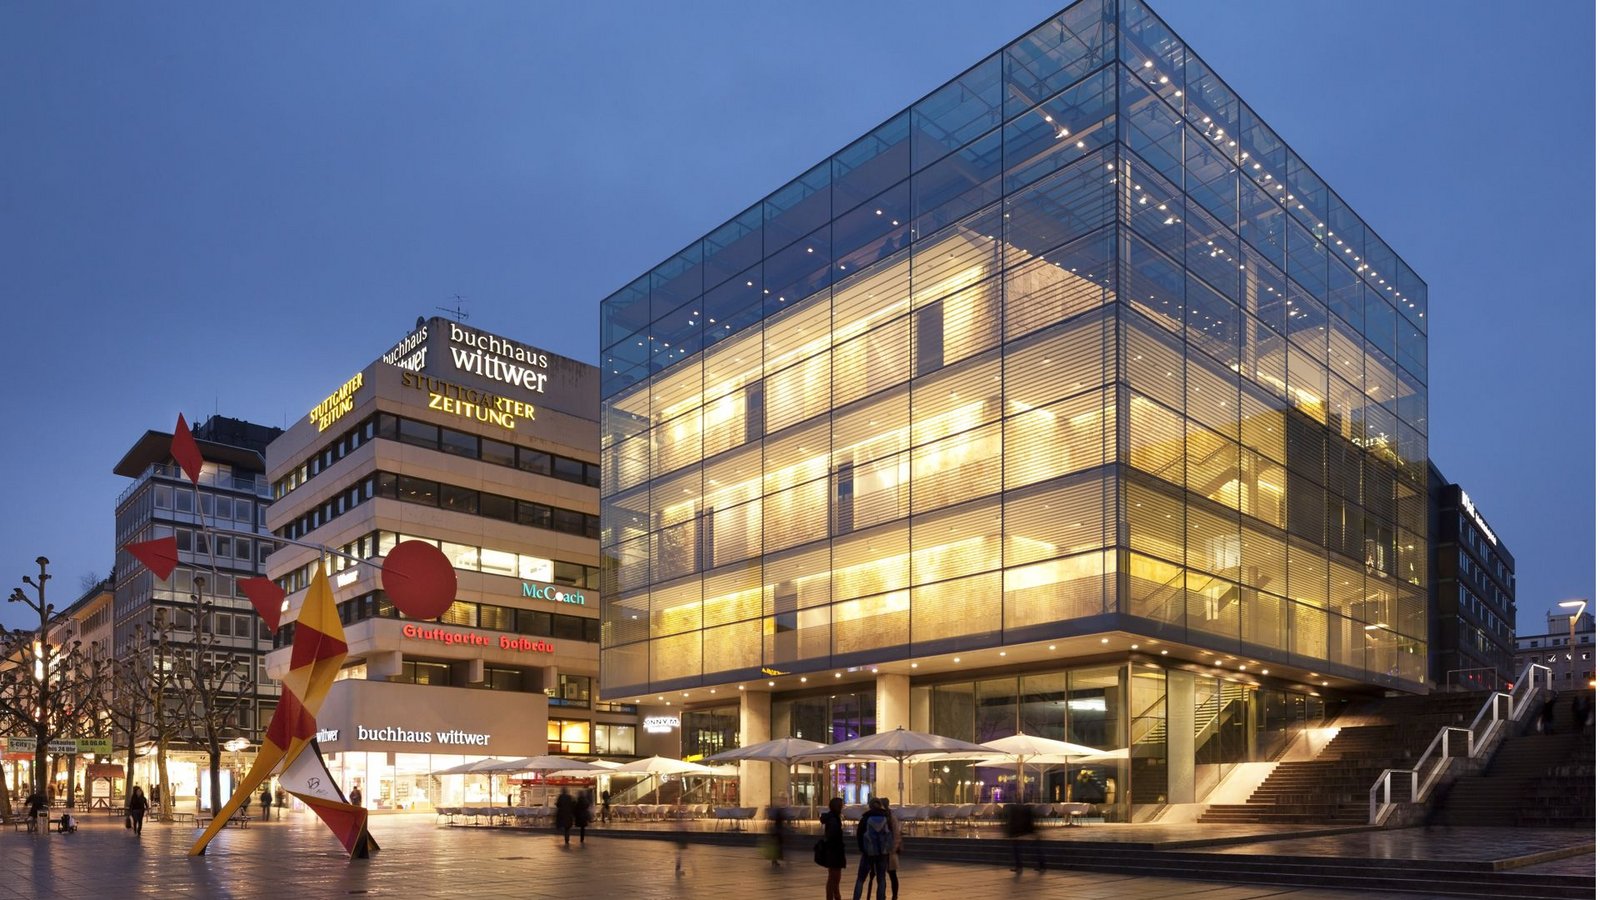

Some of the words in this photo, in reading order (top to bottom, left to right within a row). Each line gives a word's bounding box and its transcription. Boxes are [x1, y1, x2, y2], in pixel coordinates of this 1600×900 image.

[450, 323, 548, 369] buchhaus
[450, 347, 547, 394] wittwer
[309, 371, 363, 424] STUTTGARTER
[318, 395, 354, 433] ZEITUNG
[401, 371, 535, 421] STUTTGARTER
[428, 392, 516, 429] ZEITUNG
[521, 582, 585, 605] McCoach
[357, 724, 432, 743] buchhaus
[437, 728, 491, 746] wittwer
